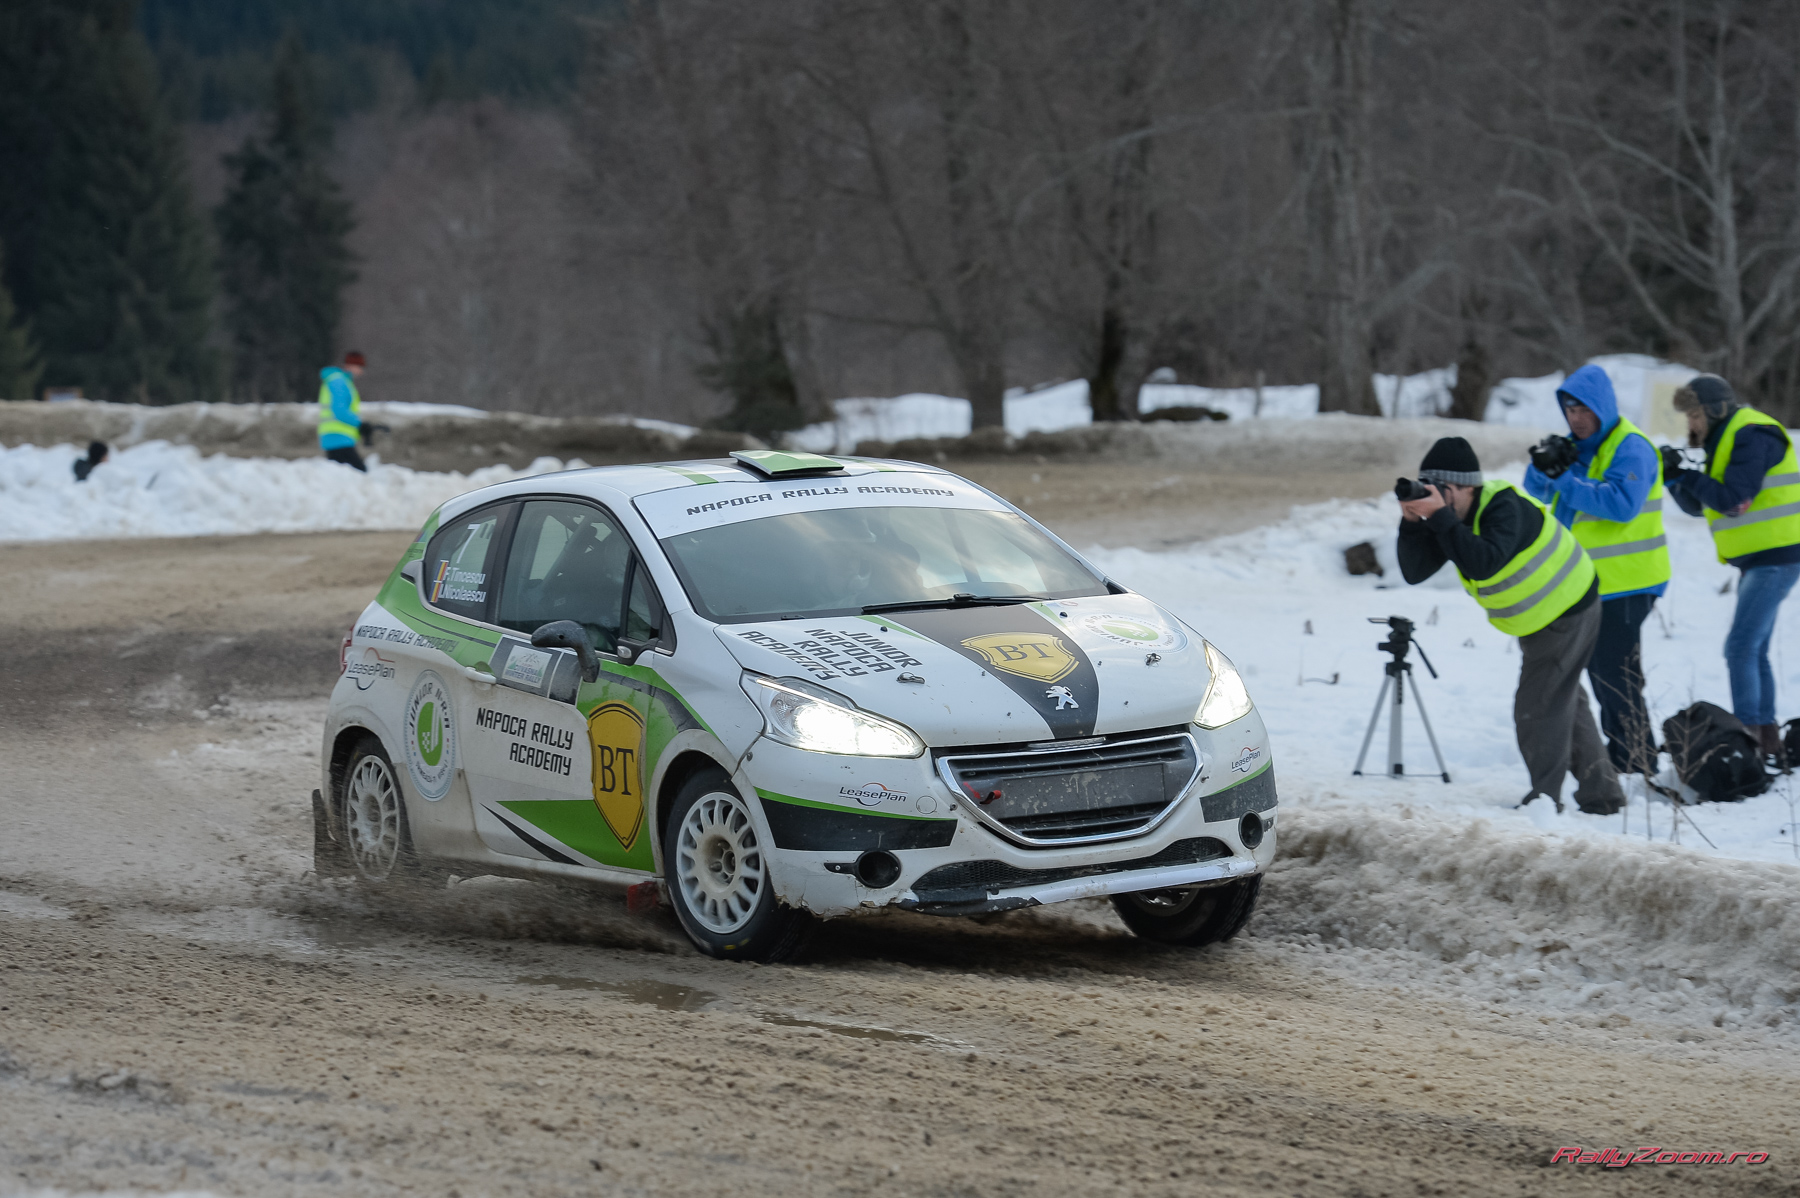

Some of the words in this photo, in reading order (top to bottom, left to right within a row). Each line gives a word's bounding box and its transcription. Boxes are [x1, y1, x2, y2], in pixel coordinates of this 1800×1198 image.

[687, 493, 773, 516] NAPOCA
[781, 486, 849, 499] RALLY
[856, 485, 955, 497] ACADEMY
[456, 523, 481, 564] 7
[355, 625, 388, 640] NAPOCA
[385, 629, 416, 645] RALLY
[413, 634, 460, 653] ACADEMY
[737, 630, 842, 681] ACADEMY
[804, 628, 896, 673] NAPOCA
[838, 630, 923, 668] JUNIOR
[988, 642, 1054, 662] BT
[348, 660, 396, 679] LeasePlan
[793, 640, 869, 677] RALLY
[409, 682, 433, 735] JUNIOR
[476, 708, 527, 738] NAPOCA
[531, 722, 574, 750] RALLY
[509, 743, 572, 776] ACADEMY
[597, 744, 635, 796] BT
[1231, 751, 1261, 769] LeasePlan
[839, 786, 907, 802] LeasePlan
